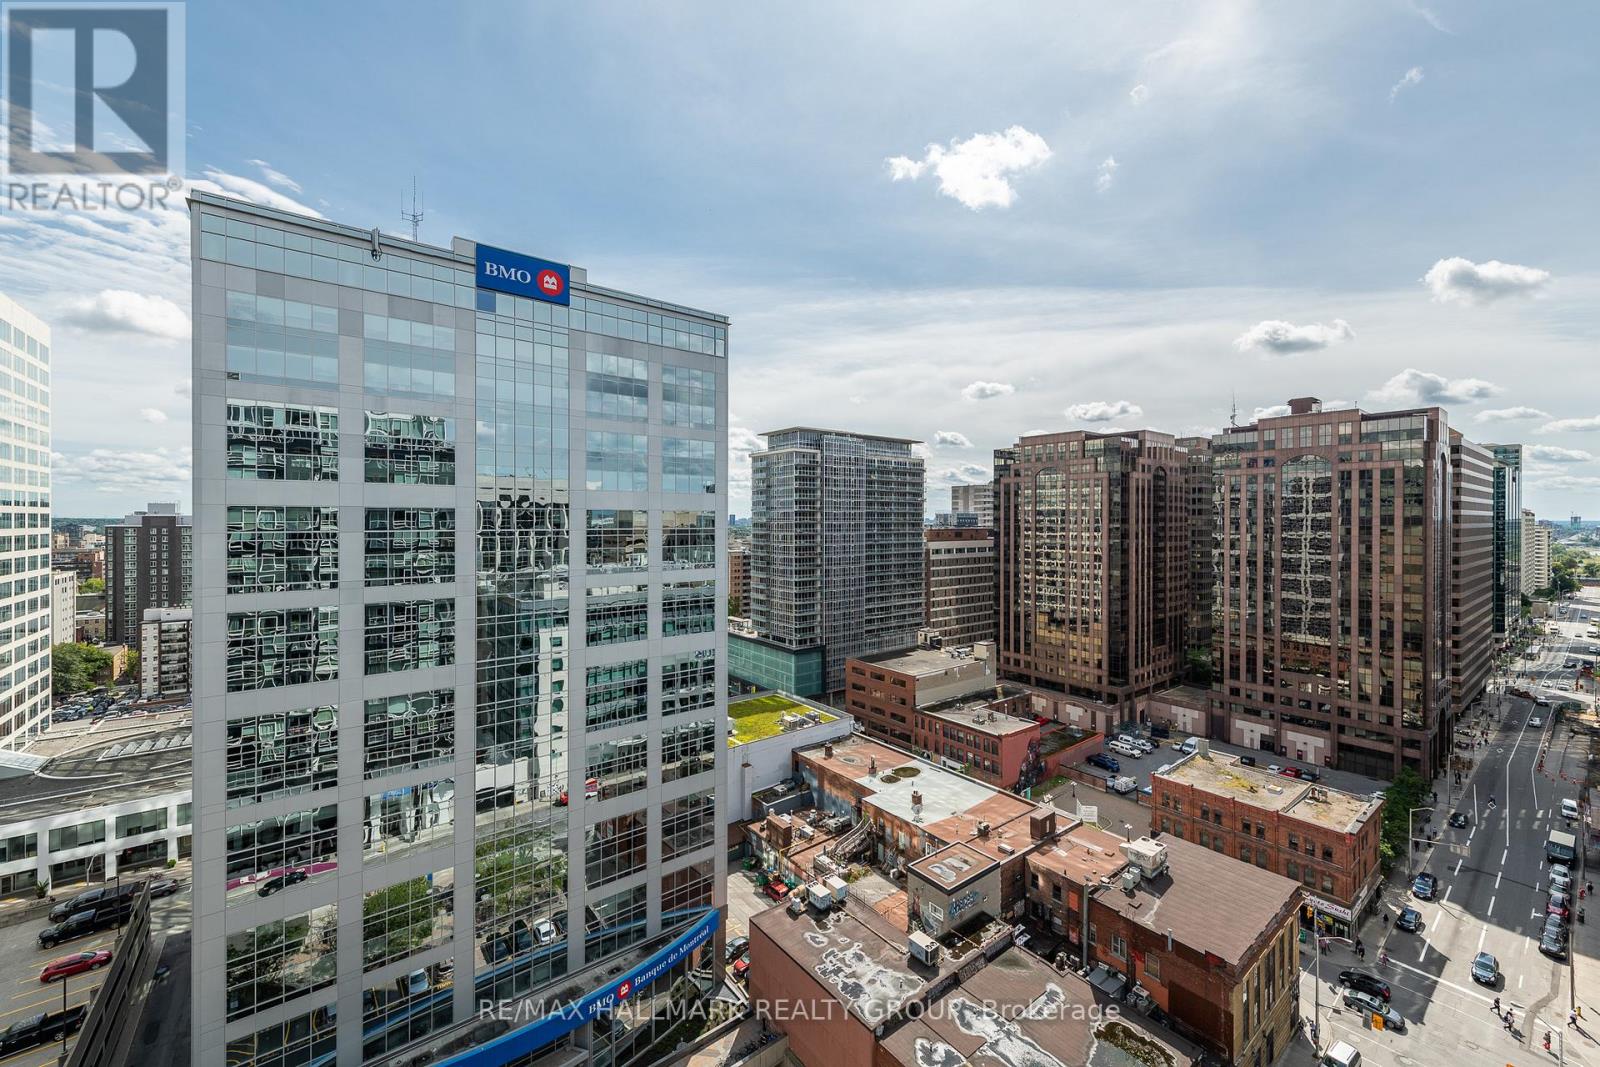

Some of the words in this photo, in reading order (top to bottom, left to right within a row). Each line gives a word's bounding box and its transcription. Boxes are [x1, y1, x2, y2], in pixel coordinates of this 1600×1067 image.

[484, 261, 531, 284] BMO
[588, 993, 615, 1014] BMO
[634, 961, 667, 986] Banque
[668, 952, 678, 965] de
